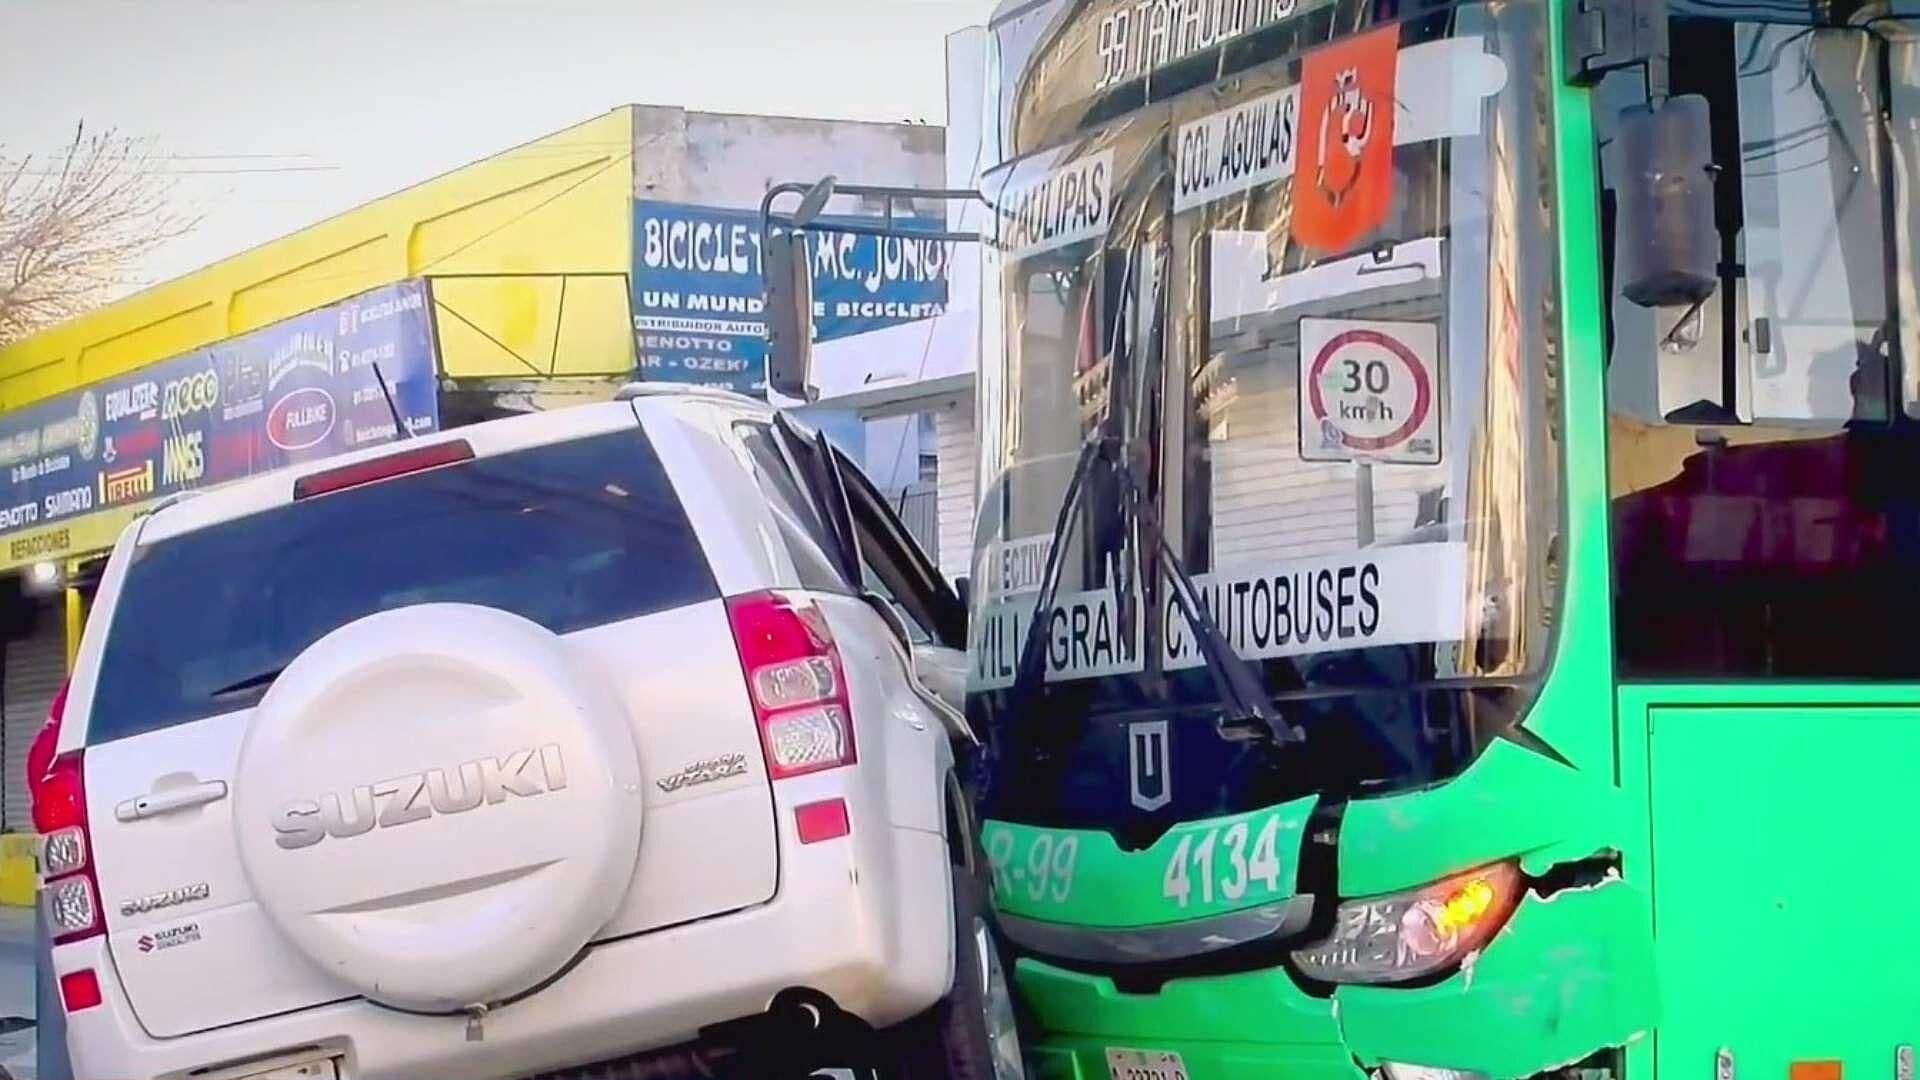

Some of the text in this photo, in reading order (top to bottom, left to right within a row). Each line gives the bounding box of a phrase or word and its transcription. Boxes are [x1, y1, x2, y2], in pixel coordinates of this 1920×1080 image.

[1181, 94, 1294, 196] COL. AGUILAS
[642, 291, 679, 308] UN
[686, 292, 767, 314] MUND
[836, 302, 945, 318] BICICLETA
[635, 316, 722, 333] ISTRIBUIDOR
[1342, 358, 1390, 394] 30
[1339, 398, 1393, 421] kmh
[0, 502, 38, 529] ENOTTO
[655, 761, 748, 793] VITARA
[271, 742, 568, 850] SUZUKI
[988, 813, 1281, 908] R-99 4134
[120, 883, 209, 917] SUZUKI
[154, 922, 199, 941] SUZUKI
